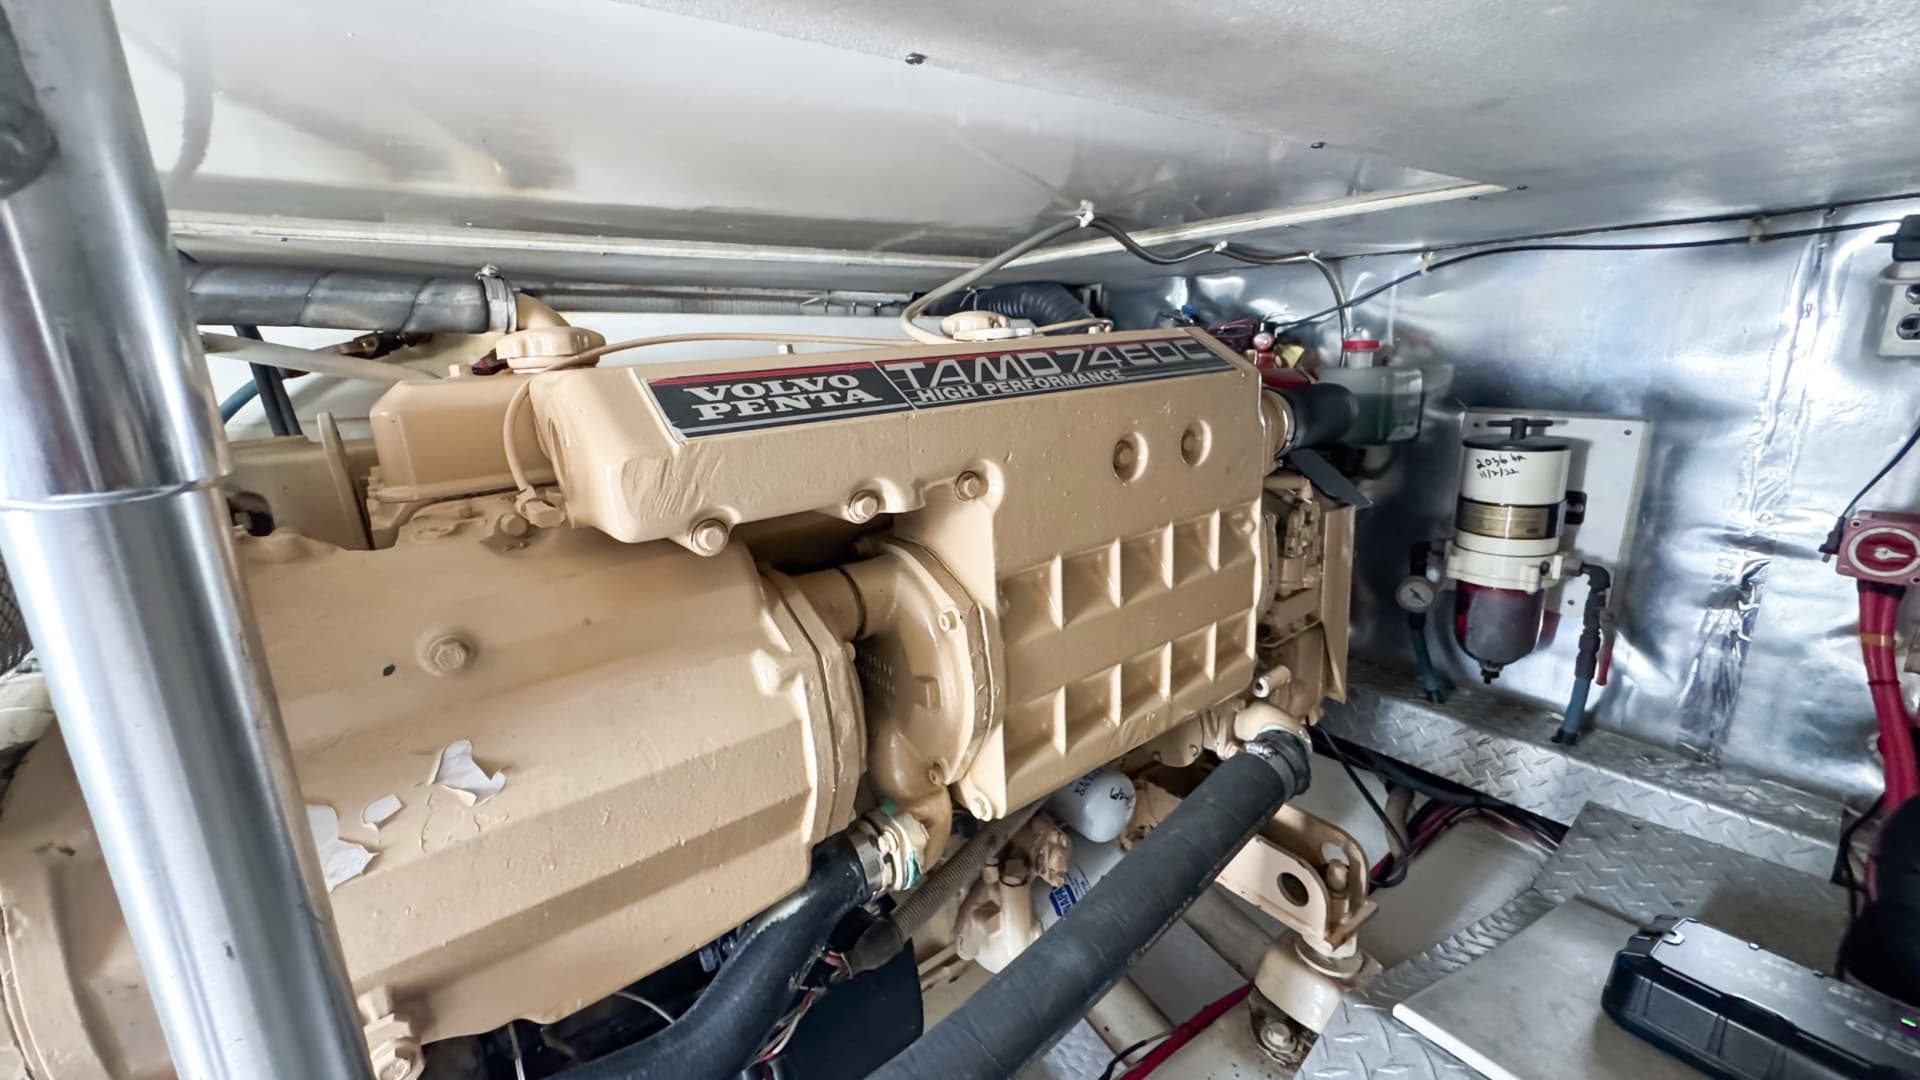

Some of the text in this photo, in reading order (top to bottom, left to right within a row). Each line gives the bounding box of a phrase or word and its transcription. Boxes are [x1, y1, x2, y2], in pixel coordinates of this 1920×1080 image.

[683, 374, 860, 402] VOLVO
[917, 368, 1126, 403] HIGH PERFORMANCE
[691, 389, 883, 421] PENTA
